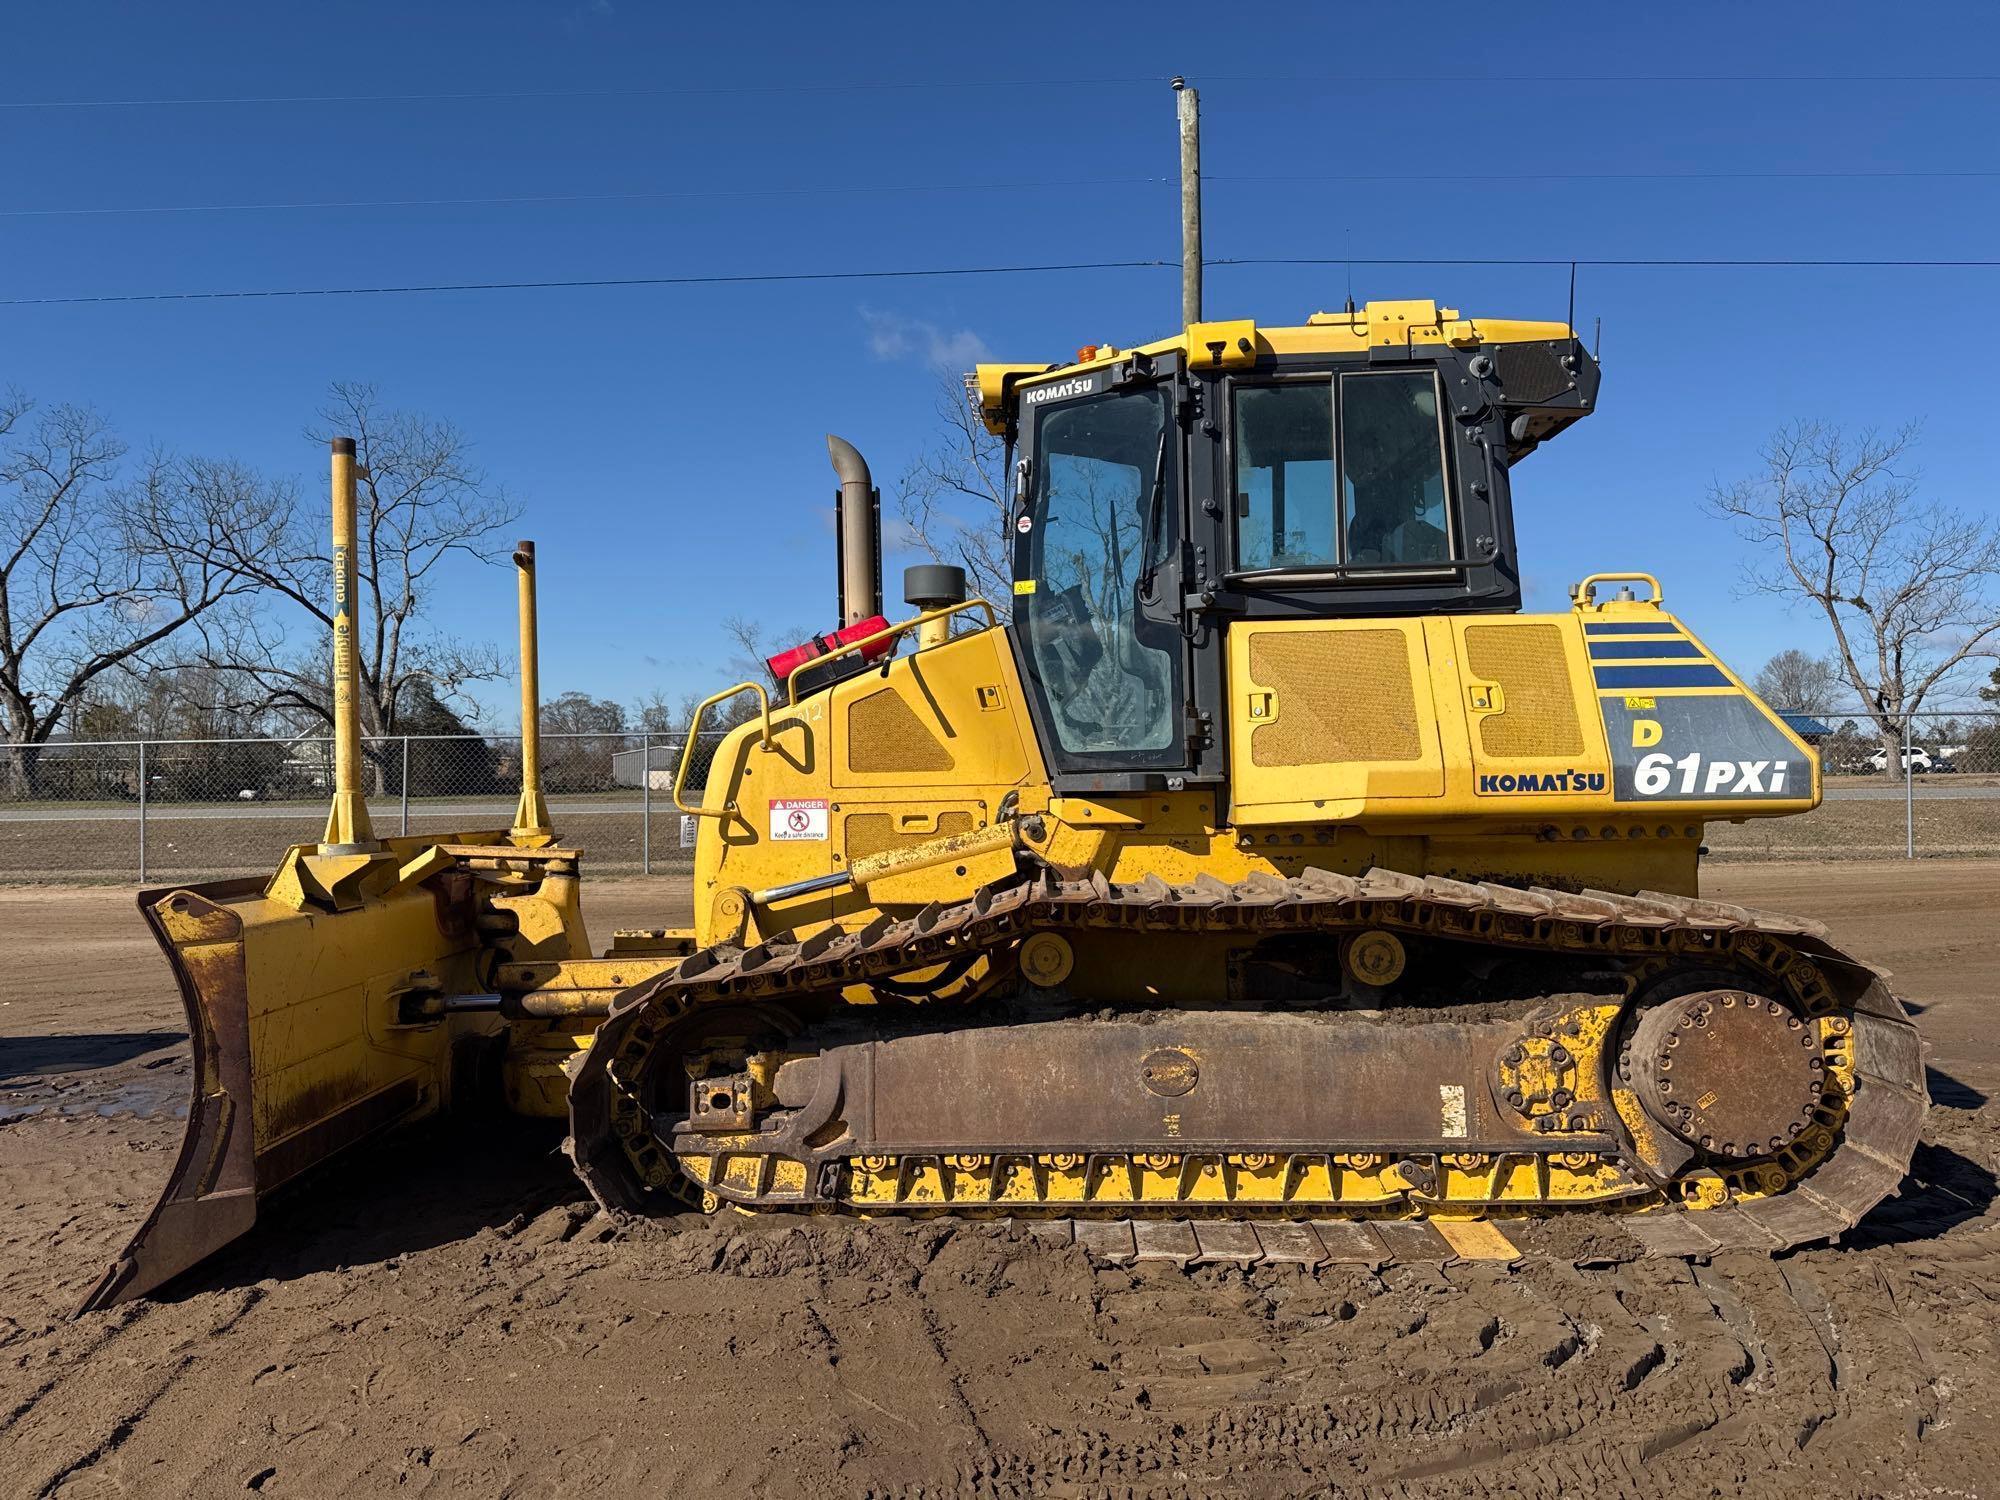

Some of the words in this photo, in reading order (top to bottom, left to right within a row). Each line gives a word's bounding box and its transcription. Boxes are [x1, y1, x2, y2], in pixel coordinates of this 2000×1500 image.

[1026, 379, 1092, 403] KOMATSU
[335, 551, 346, 603] GUIDED
[1632, 719, 1663, 747] D
[1480, 768, 1605, 792] KOMATSU
[786, 801, 824, 809] DANGER
